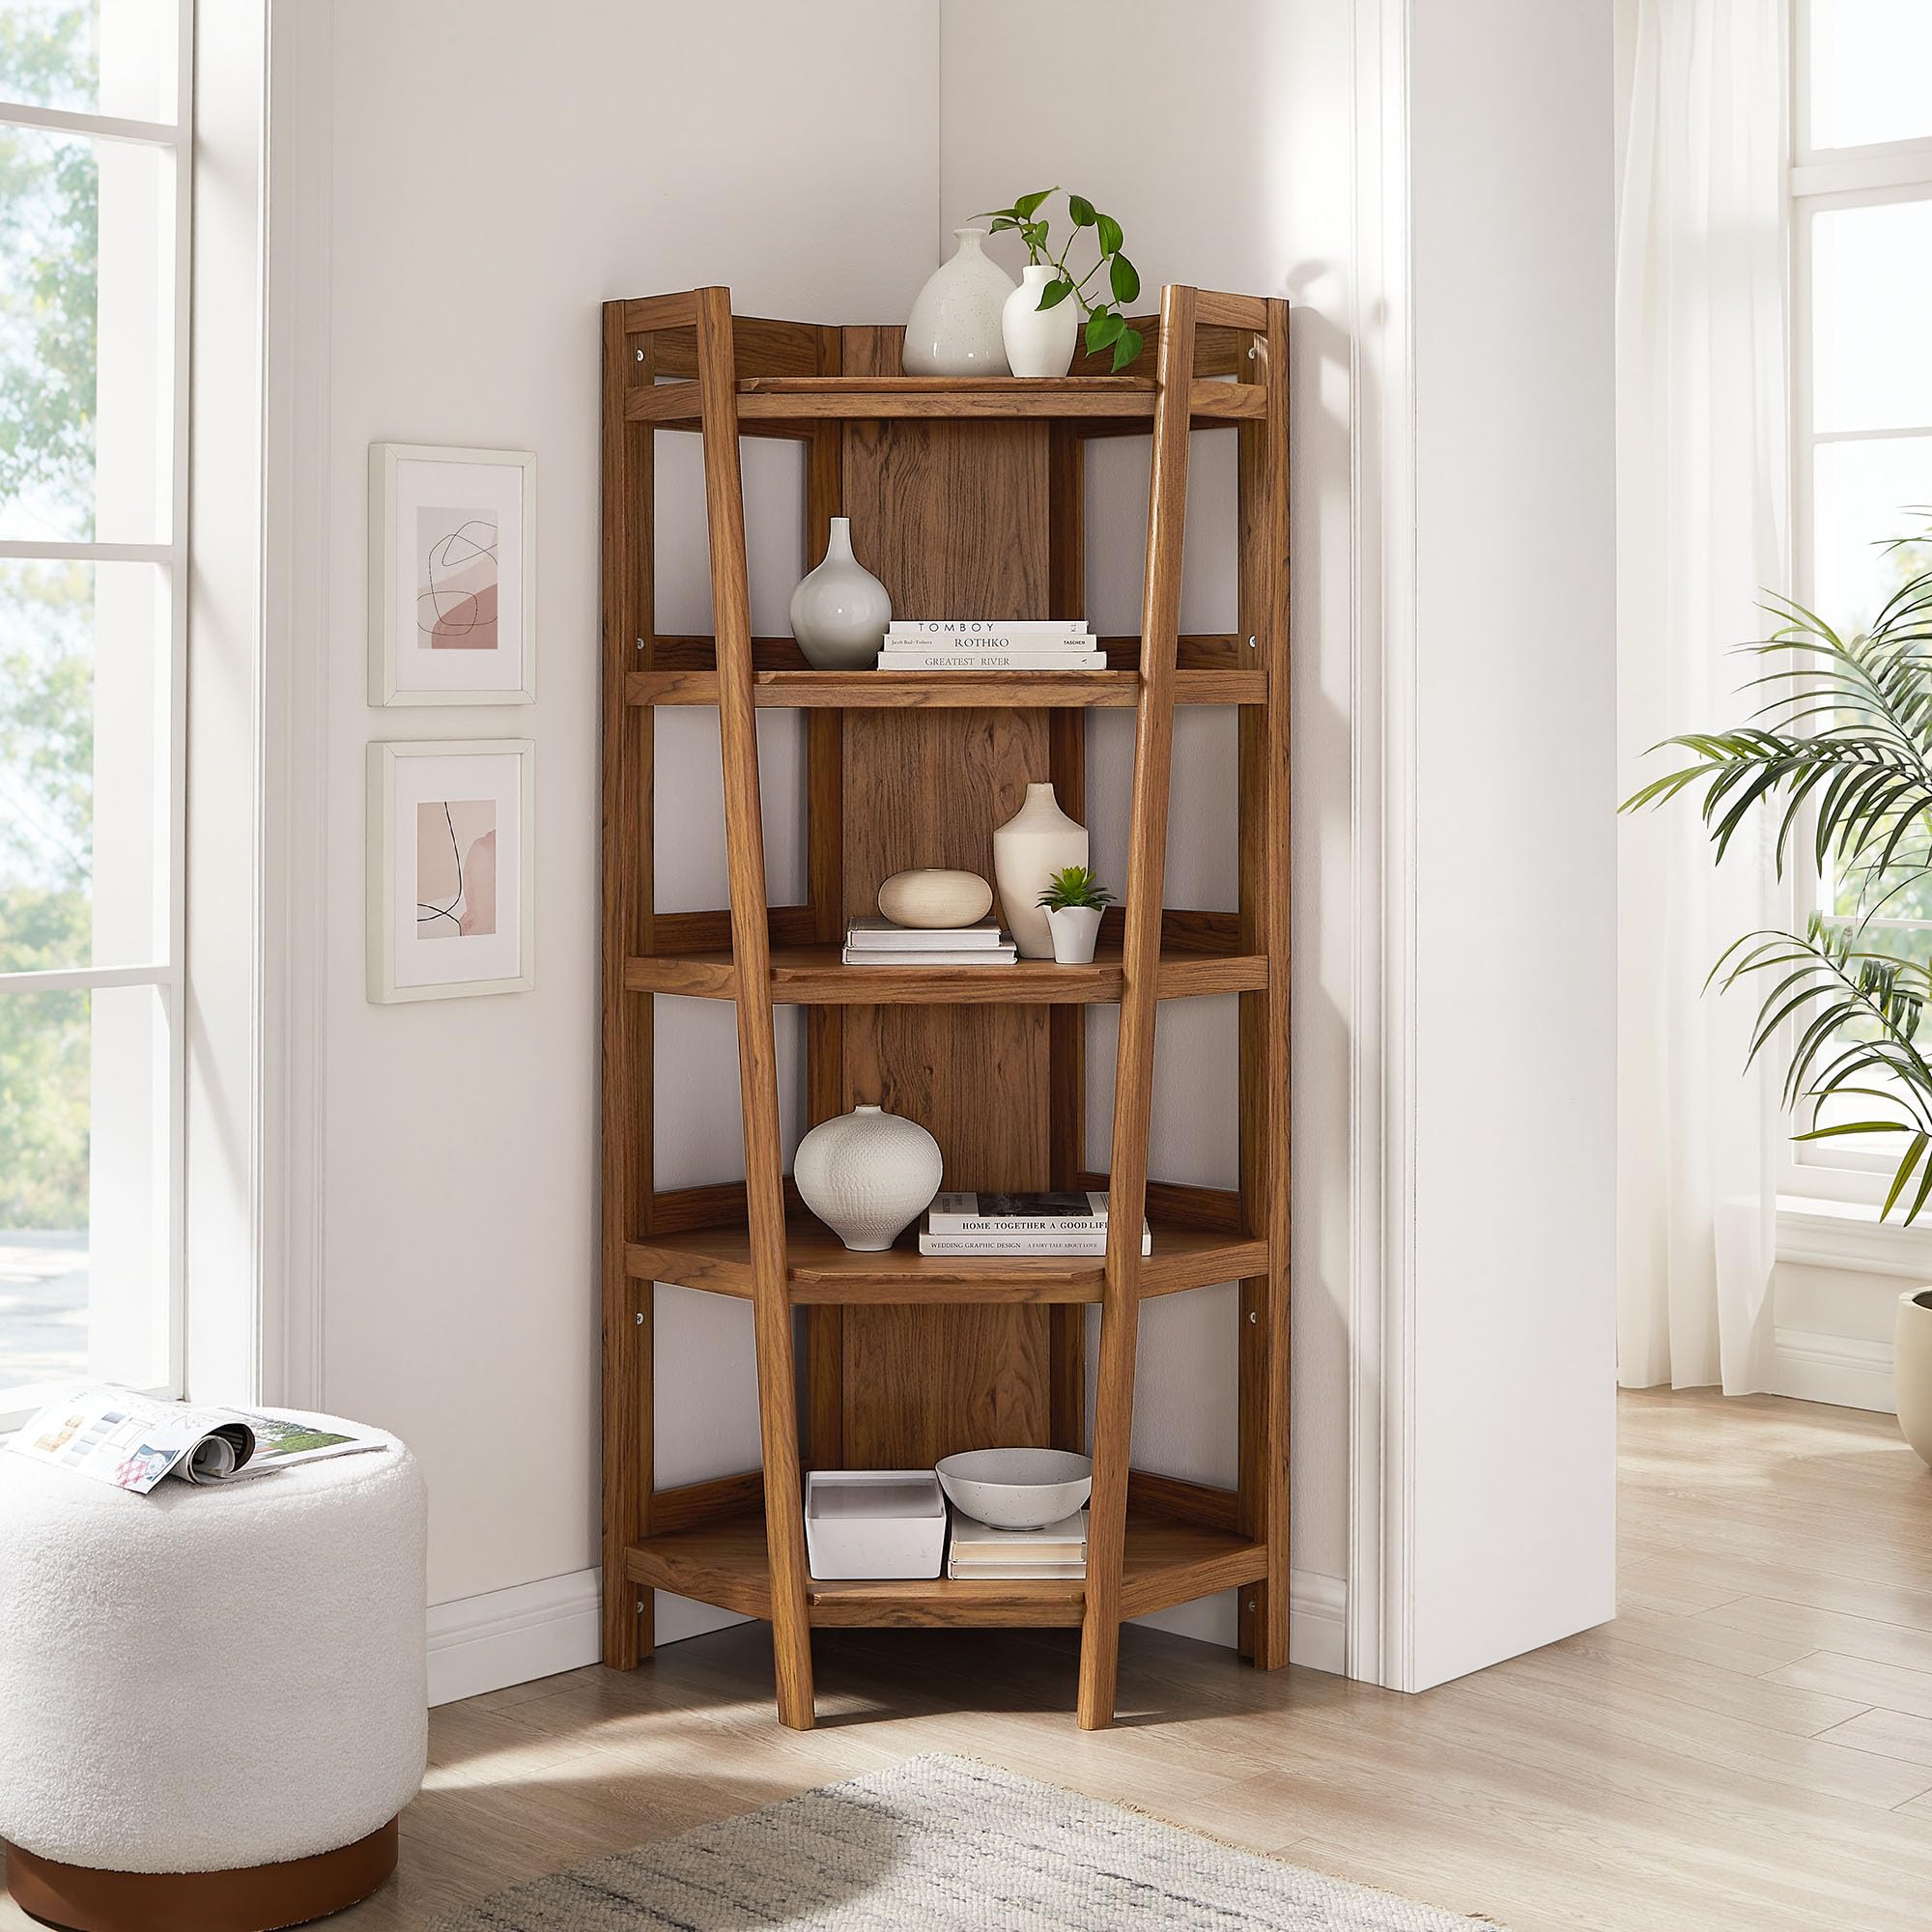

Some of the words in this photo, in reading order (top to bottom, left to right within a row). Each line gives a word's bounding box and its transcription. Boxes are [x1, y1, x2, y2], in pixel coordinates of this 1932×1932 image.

[918, 622, 994, 633] TOMBOY
[954, 638, 1009, 648] ROTHKO
[924, 657, 975, 666] GREATEST
[980, 657, 1010, 666] RIVER
[962, 1221, 991, 1231] HOME
[994, 1221, 1046, 1231] TOGETHER
[1049, 1221, 1056, 1231] A
[1060, 1221, 1088, 1231] GOOD
